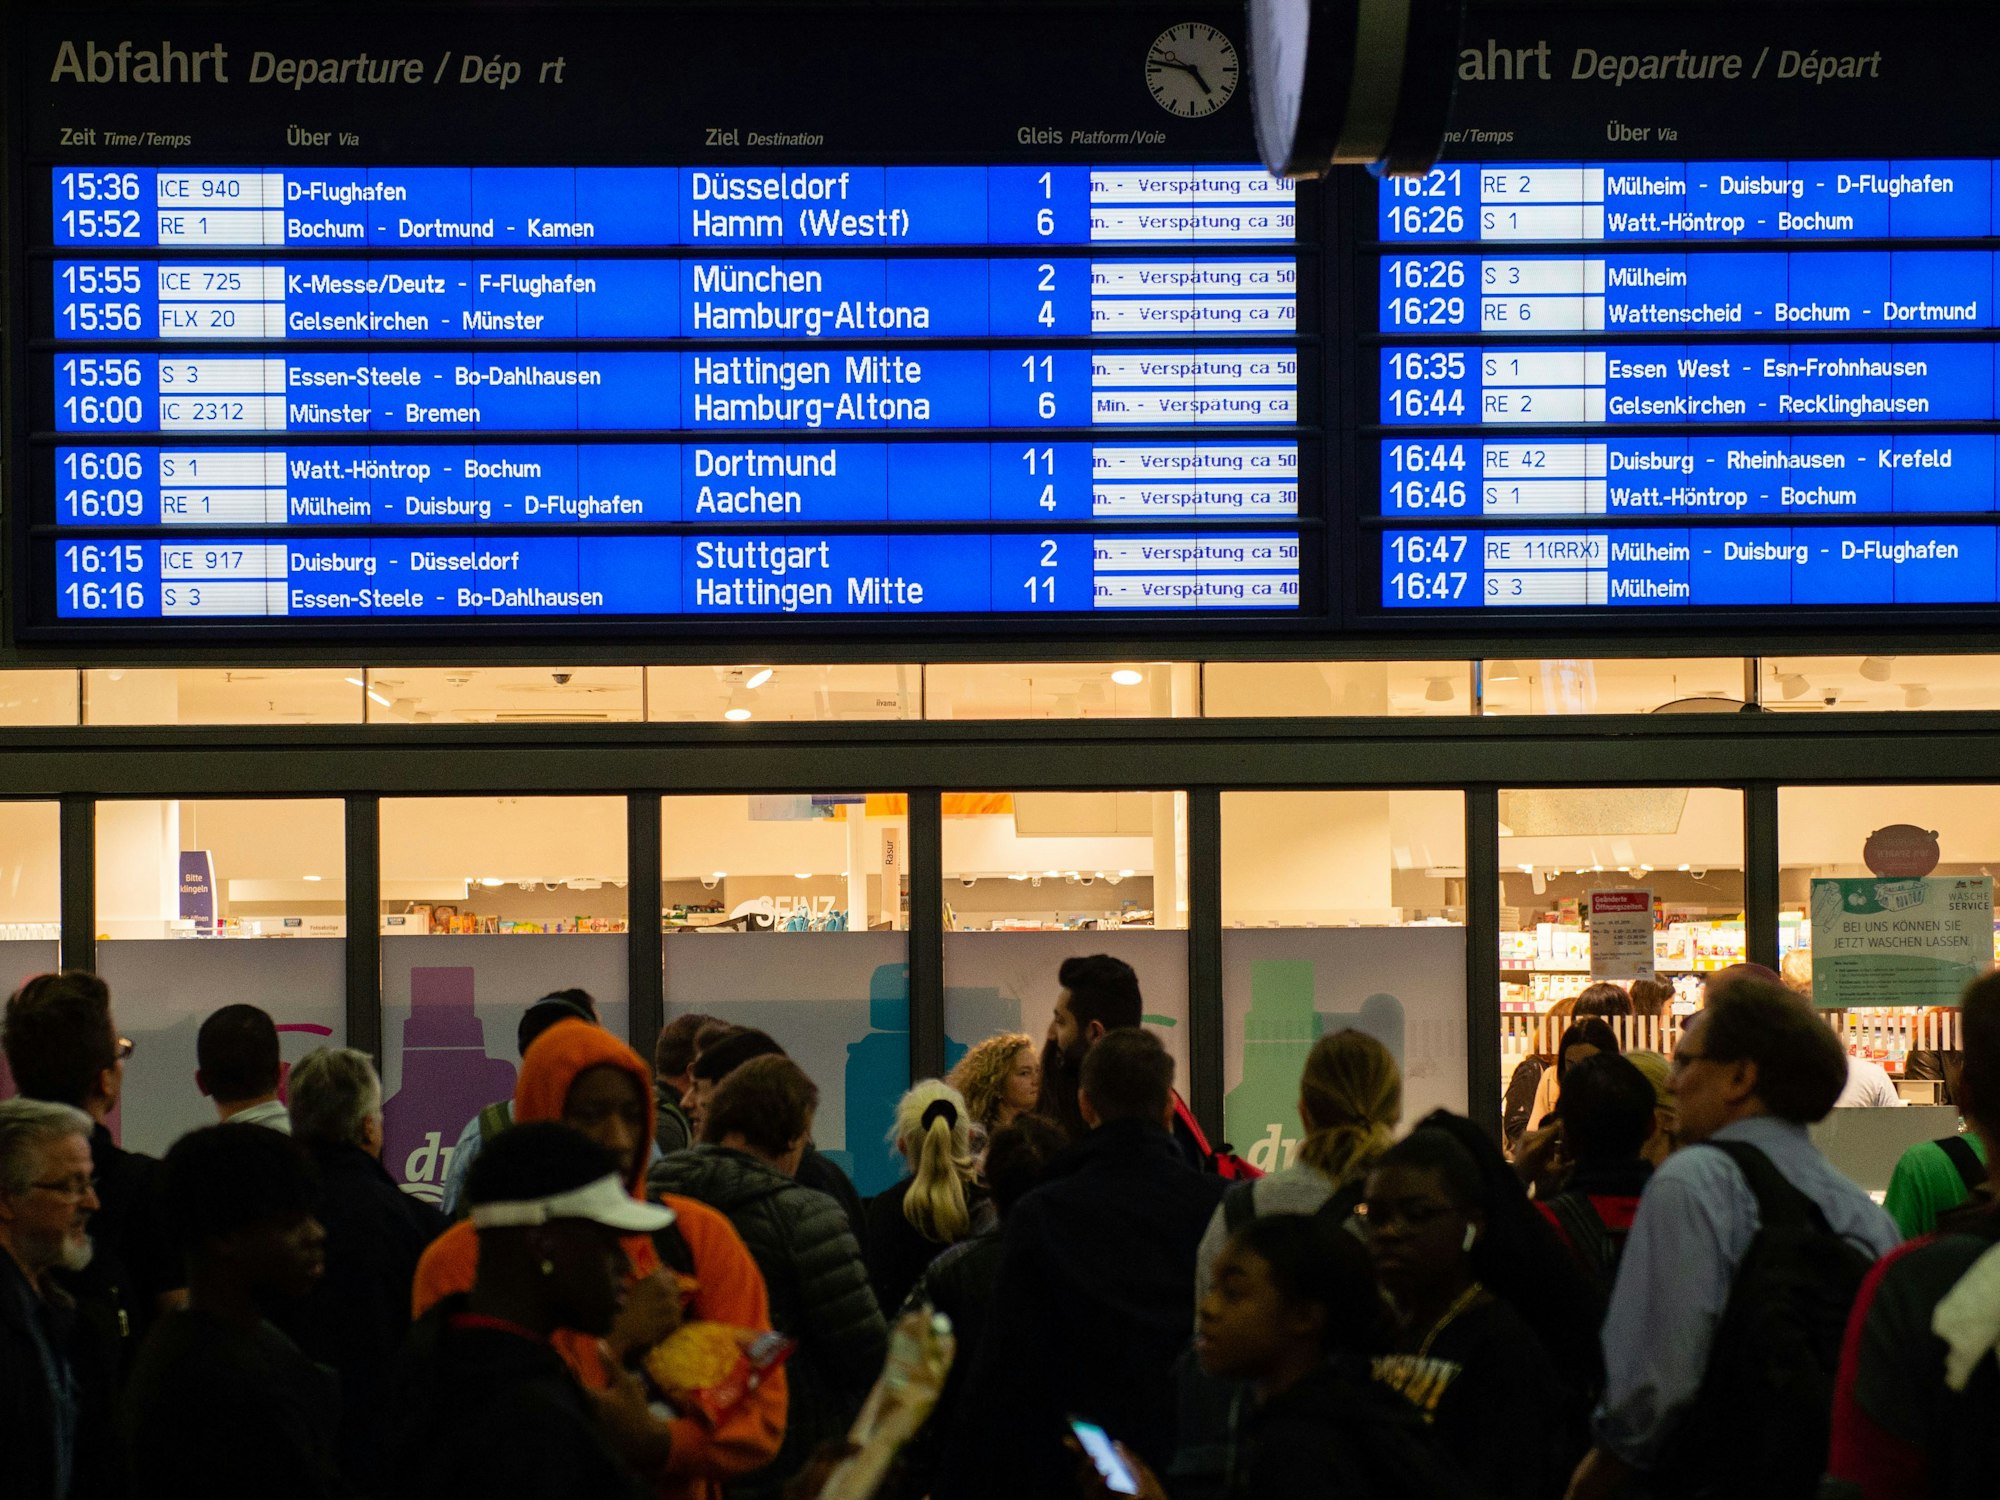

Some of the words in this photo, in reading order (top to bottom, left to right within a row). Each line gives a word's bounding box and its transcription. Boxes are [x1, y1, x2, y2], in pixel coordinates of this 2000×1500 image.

[50, 41, 229, 84] Abfahrt
[249, 51, 424, 91] Departure
[434, 52, 451, 84] /
[1457, 39, 1552, 82] ahrt
[1571, 48, 1742, 87] Departure
[1752, 47, 1770, 80] /
[1777, 48, 1882, 85] Départ
[60, 127, 97, 146] Zeit
[103, 131, 193, 149] Time/Temps
[287, 124, 332, 146] Über
[339, 132, 360, 146] Via
[705, 127, 740, 146] Ziel
[747, 131, 824, 147] Destination
[1017, 126, 1063, 145] Gleis
[1070, 130, 1166, 147] Platform/Voie
[1443, 127, 1514, 146] me/Temps
[1607, 120, 1651, 142] Über
[1657, 127, 1678, 142] Via
[60, 172, 140, 201] 15:36
[160, 179, 190, 198] ICE
[201, 179, 240, 198] 940
[287, 181, 407, 206] D-Flughafen
[692, 172, 850, 200] Düsseldorf
[1038, 171, 1051, 199] 1
[1387, 168, 1461, 197] 16:21
[1607, 176, 1686, 196] Mülheim
[1720, 175, 1804, 199] Duisburg
[1837, 173, 1954, 198] D-Flughafen
[61, 209, 141, 238] 15:52
[160, 216, 185, 235] RE
[198, 217, 207, 235] 1
[287, 218, 365, 238] Bochum
[399, 218, 494, 238] Dortmund
[527, 218, 595, 238] Kamen
[693, 209, 783, 237] Hamm
[799, 208, 909, 237] (Westf)
[1037, 208, 1055, 236] 6
[1248, 218, 1268, 228] ca
[1387, 205, 1464, 234] 16:26
[1607, 212, 1745, 236] Watt.-Höntrop
[1778, 211, 1854, 231] Bochum
[62, 265, 141, 294] 15:55
[161, 272, 191, 291] ICE
[202, 272, 241, 291] 725
[288, 274, 446, 294] K-Messe/Deutz
[479, 273, 596, 298] F-Flughafen
[693, 264, 822, 293] München
[1038, 263, 1056, 292] 2
[1388, 260, 1465, 288] 16:26
[1608, 267, 1687, 287] Mülheim
[62, 302, 142, 331] 15:56
[162, 310, 198, 328] FLX
[210, 310, 235, 328] 20
[289, 311, 429, 331] Gelsenkirchen
[462, 310, 545, 331] Münster
[693, 301, 930, 337] Hamburg-Altona
[1038, 300, 1056, 328] 4
[1388, 297, 1465, 325] 16:29
[1608, 303, 1742, 323] Wattenscheid
[1775, 302, 1851, 322] Bochum
[1883, 301, 1977, 321] Dortmund
[62, 358, 142, 387] 15:56
[289, 366, 421, 387] Essen-Steele
[455, 366, 601, 386] Bo-Dahlhausen
[694, 356, 830, 391] Hattingen
[845, 356, 921, 384] Mitte
[1021, 355, 1053, 383] 11
[1388, 352, 1466, 380] 16:35
[1609, 359, 1667, 379] Essen
[1677, 358, 1730, 378] West
[1763, 357, 1928, 378] Esn-Frohnhausen
[63, 395, 143, 424] 16:00
[162, 402, 181, 420] IC
[192, 402, 244, 420] 2312
[289, 403, 372, 423] Münster
[406, 403, 481, 423] Bremen
[694, 392, 930, 428] Hamburg-Altona
[1038, 392, 1056, 419] 6
[1097, 400, 1130, 412] Min.
[1159, 399, 1261, 415] Verspätung
[1268, 399, 1289, 411] ca
[1388, 388, 1466, 417] 16:44
[1609, 395, 1746, 415] Gelsenkirchen
[1779, 393, 1929, 418] Recklinghausen
[63, 452, 143, 480] 16:06
[290, 459, 431, 484] Watt.-Höntrop
[464, 458, 541, 479] Bochum
[695, 448, 837, 477] Dortmund
[1022, 447, 1054, 476] 11
[1389, 444, 1466, 472] 16:44
[1486, 450, 1509, 468] RE
[1521, 450, 1546, 468] 42
[1610, 451, 1694, 475] Duisburg
[1727, 450, 1846, 470] Rheinhausen
[1878, 448, 1952, 468] Krefeld
[64, 489, 143, 517] 16:09
[290, 496, 371, 516] Mülheim
[405, 496, 491, 520] Duisburg
[524, 494, 643, 519] D-Flughafen
[695, 485, 801, 514] Aachen
[1039, 484, 1057, 512] 4
[1389, 480, 1467, 509] 16:46
[1610, 486, 1748, 511] Watt.-Höntrop
[1781, 486, 1857, 506] Bochum
[64, 544, 144, 573] 16:15
[163, 551, 193, 569] ICE
[205, 551, 244, 569] 917
[696, 540, 830, 576] Stuttgart
[1040, 540, 1058, 567] 2
[1390, 535, 1468, 563] 16:47
[1487, 541, 1511, 560] RE
[1524, 541, 1600, 559] 11(RRX)
[1611, 542, 1690, 562] Mülheim
[1724, 541, 1809, 565] Duisburg
[1841, 539, 1959, 564] D-Flughafen
[290, 552, 377, 576] Duisburg
[410, 551, 520, 571] Düsseldorf
[65, 581, 144, 610] 16:16
[291, 588, 424, 609] Essen-Steele
[457, 587, 603, 607] Bo-Dahlhausen
[696, 577, 832, 612] Hattingen
[847, 577, 923, 605] Mitte
[1023, 577, 1055, 604] 11
[1390, 571, 1468, 600] 16:47
[1611, 578, 1690, 598] Mülheim
[885, 840, 894, 865] Rasur
[185, 874, 203, 882] Bitte
[1949, 901, 1990, 911] SERVICE
[1843, 921, 1861, 933] BEI
[1865, 921, 1888, 932] UNS
[1893, 919, 1940, 932] KÖNNEN
[1944, 920, 1961, 932] SIE
[1833, 937, 1865, 949] JETZT
[1869, 936, 1922, 948] WASCHEN
